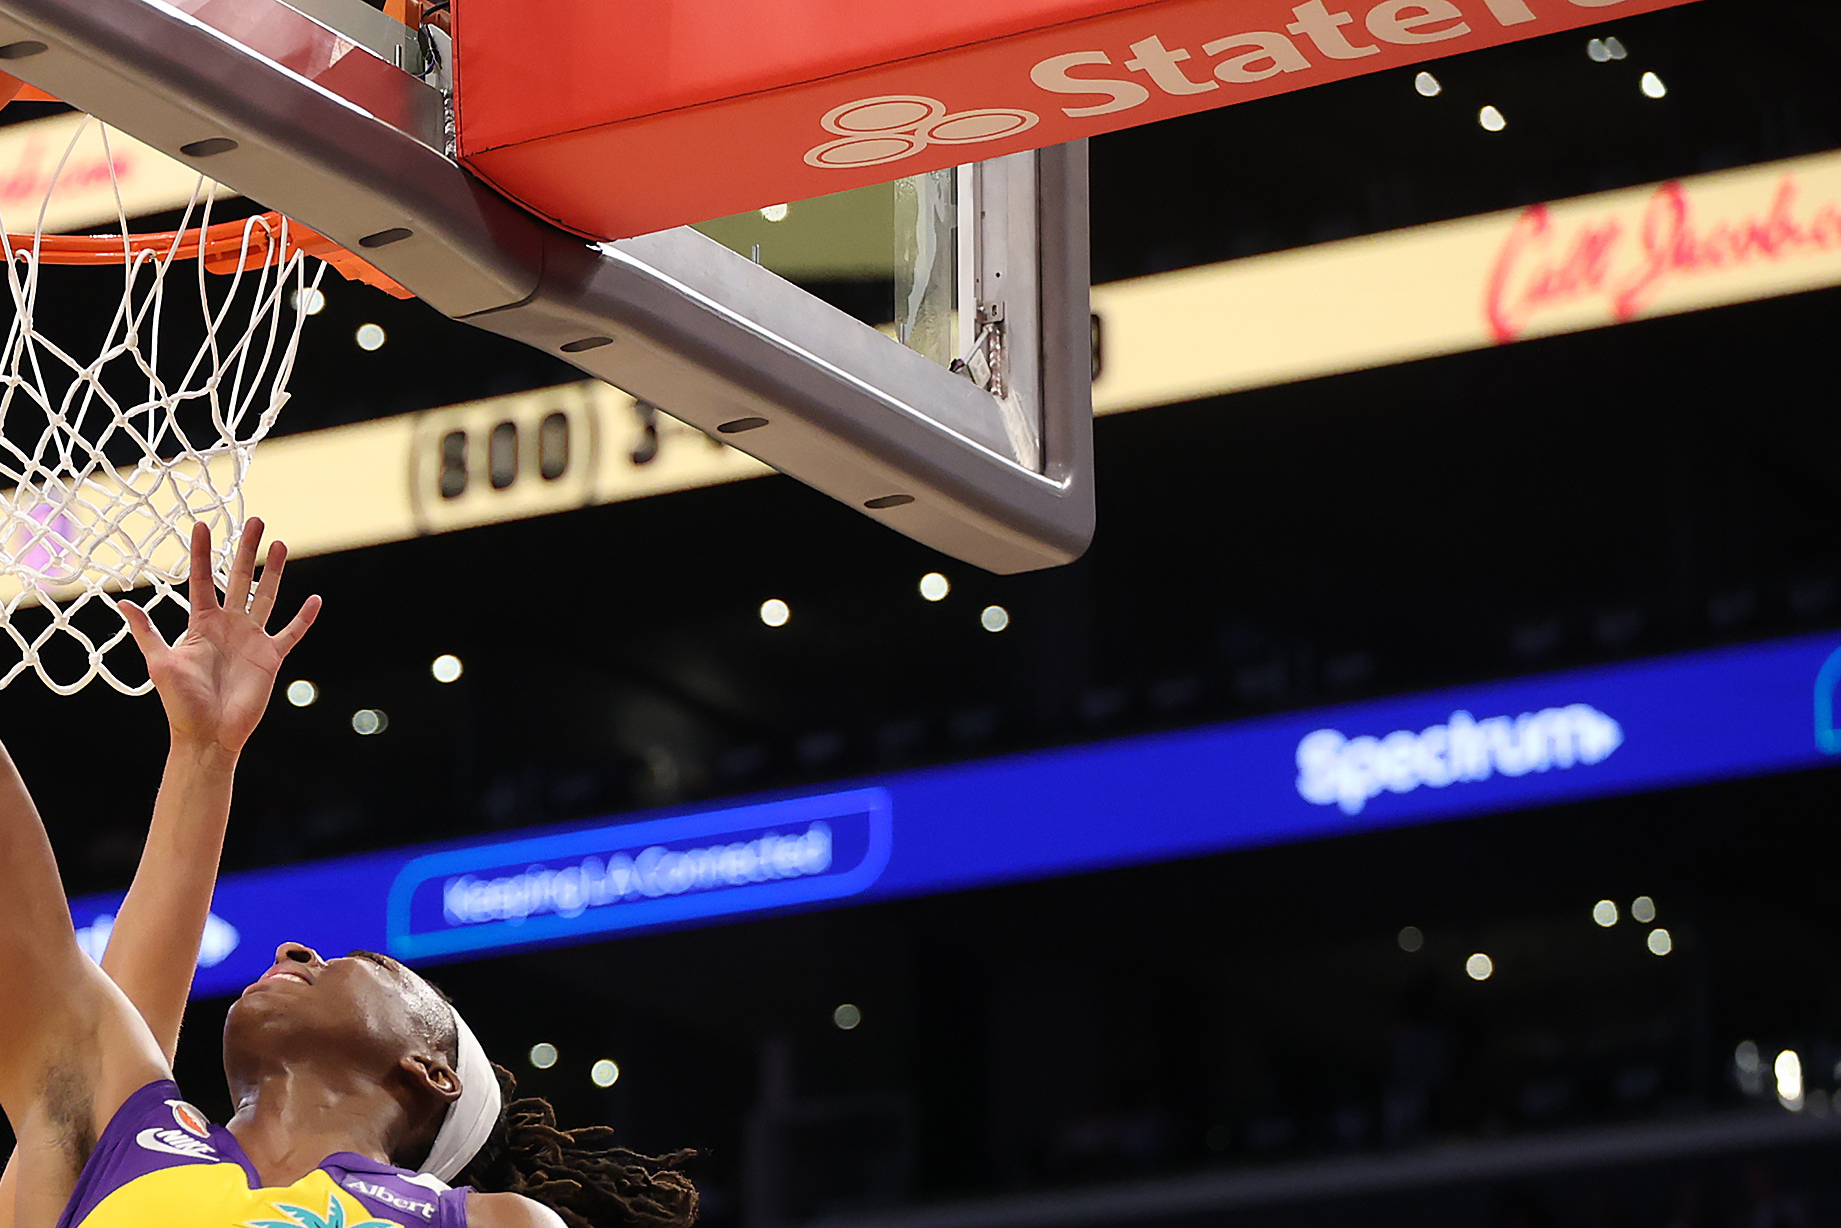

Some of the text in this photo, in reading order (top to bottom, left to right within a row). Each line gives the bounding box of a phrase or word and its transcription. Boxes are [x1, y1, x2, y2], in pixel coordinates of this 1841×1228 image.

[1031, 0, 1472, 118] State
[1296, 703, 1605, 816] Spectrum
[346, 1180, 437, 1219] Albert
